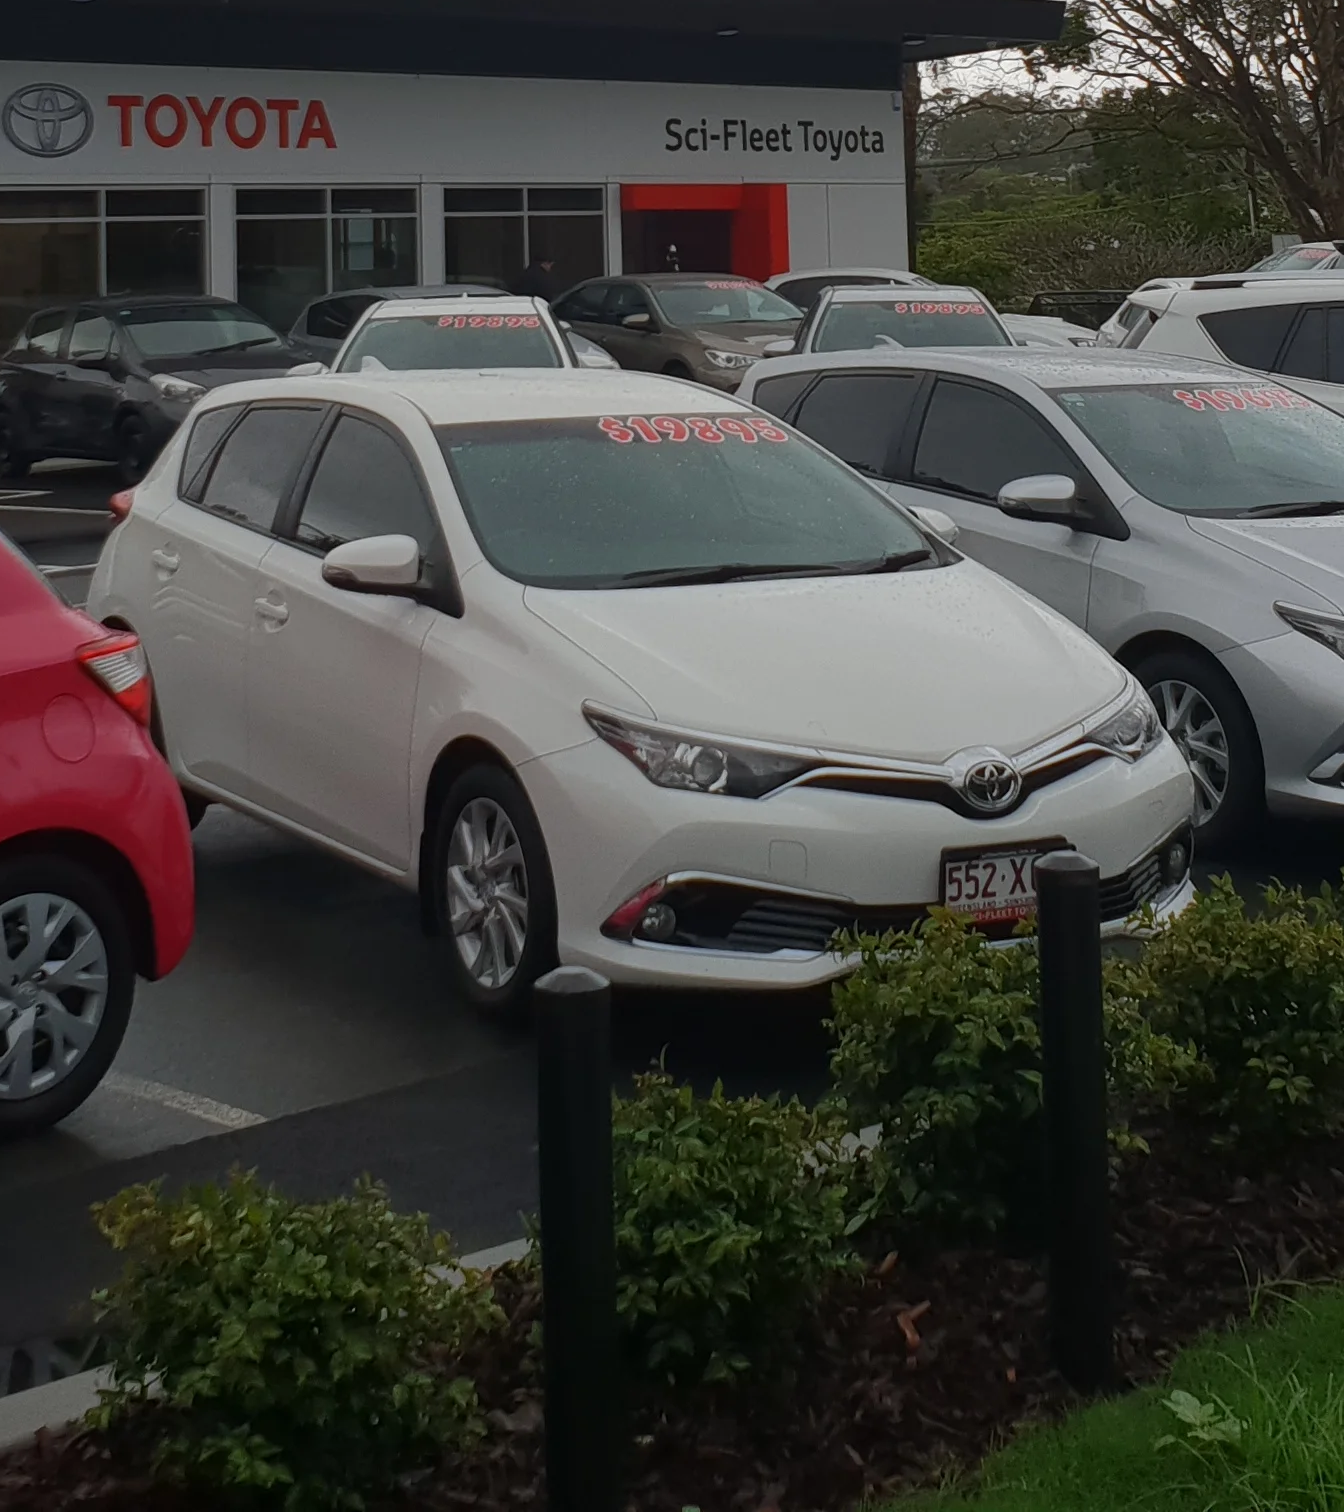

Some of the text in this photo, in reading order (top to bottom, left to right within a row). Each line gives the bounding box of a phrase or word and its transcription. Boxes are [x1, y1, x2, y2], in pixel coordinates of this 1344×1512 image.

[107, 93, 337, 149] TOYOTA
[665, 118, 885, 161] Sci-Fleet Toyota
[438, 315, 540, 329] $19895
[598, 416, 789, 444] $19895
